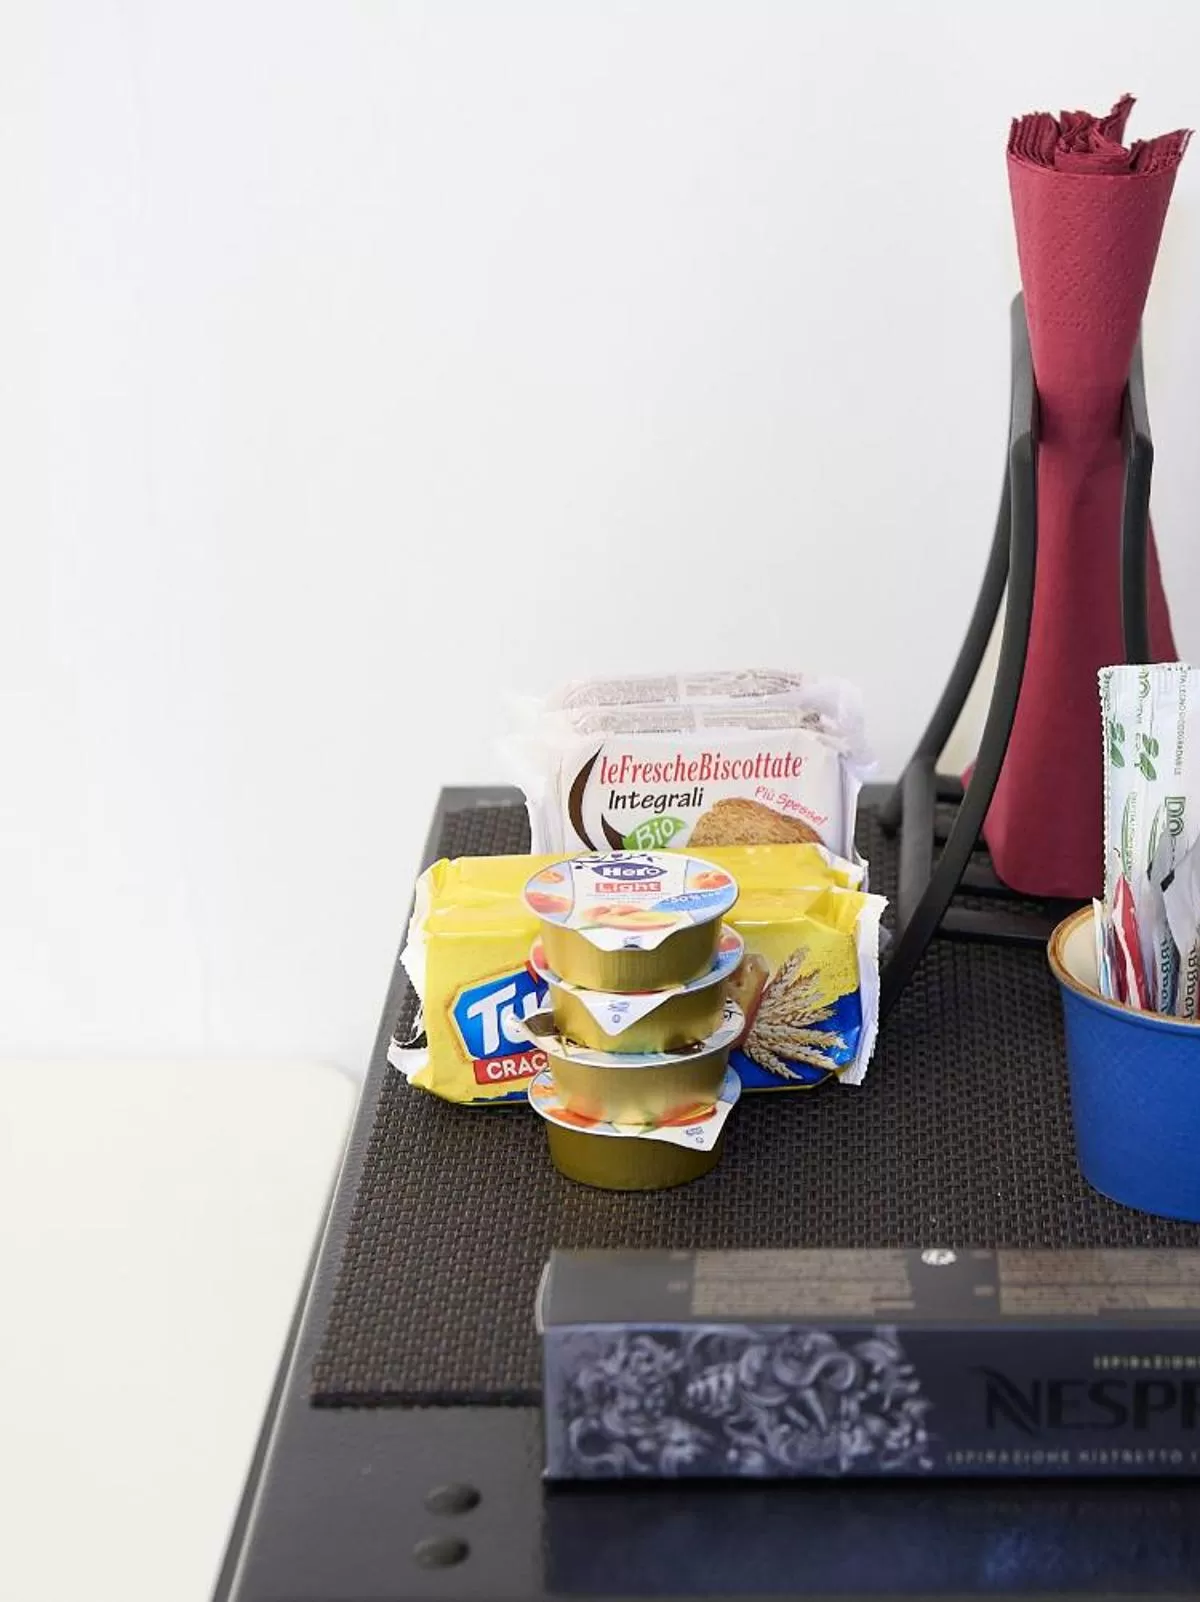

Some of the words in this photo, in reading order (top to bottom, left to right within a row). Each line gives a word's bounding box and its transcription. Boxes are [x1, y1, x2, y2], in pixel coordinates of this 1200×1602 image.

[608, 786, 704, 814] Integrali
[634, 818, 675, 850] Bio
[601, 866, 661, 877] Hero
[596, 881, 662, 893] Light
[485, 1053, 548, 1079] CRAC
[946, 1449, 1070, 1465] ISPIRAZIONE
[1078, 1449, 1184, 1465] RISTRETTO
